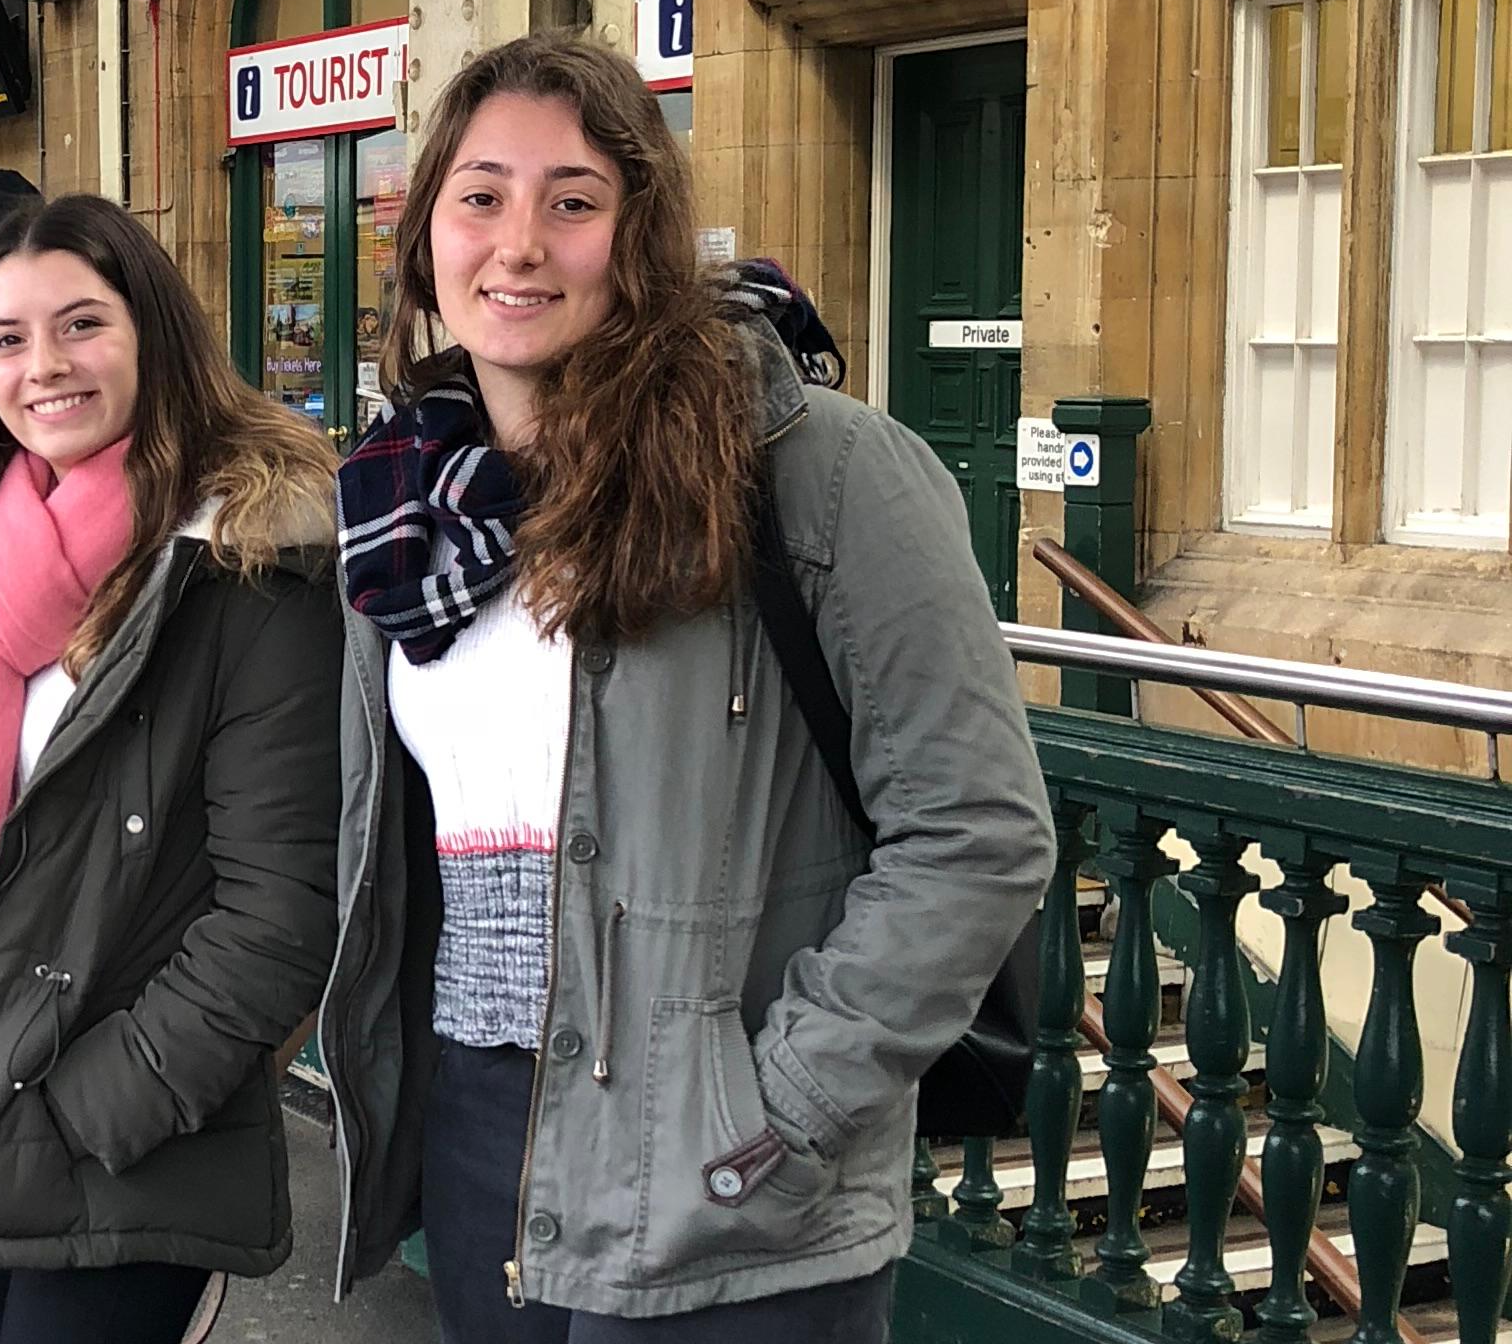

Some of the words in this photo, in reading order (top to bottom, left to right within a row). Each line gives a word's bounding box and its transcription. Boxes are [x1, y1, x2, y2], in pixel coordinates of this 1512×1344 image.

[273, 46, 389, 111] TOURIST
[961, 325, 1010, 344] Private
[266, 356, 278, 374] Buy
[304, 357, 322, 373] Here
[1030, 426, 1062, 439] Please
[1021, 456, 1062, 468] provided
[1028, 470, 1053, 484] using
